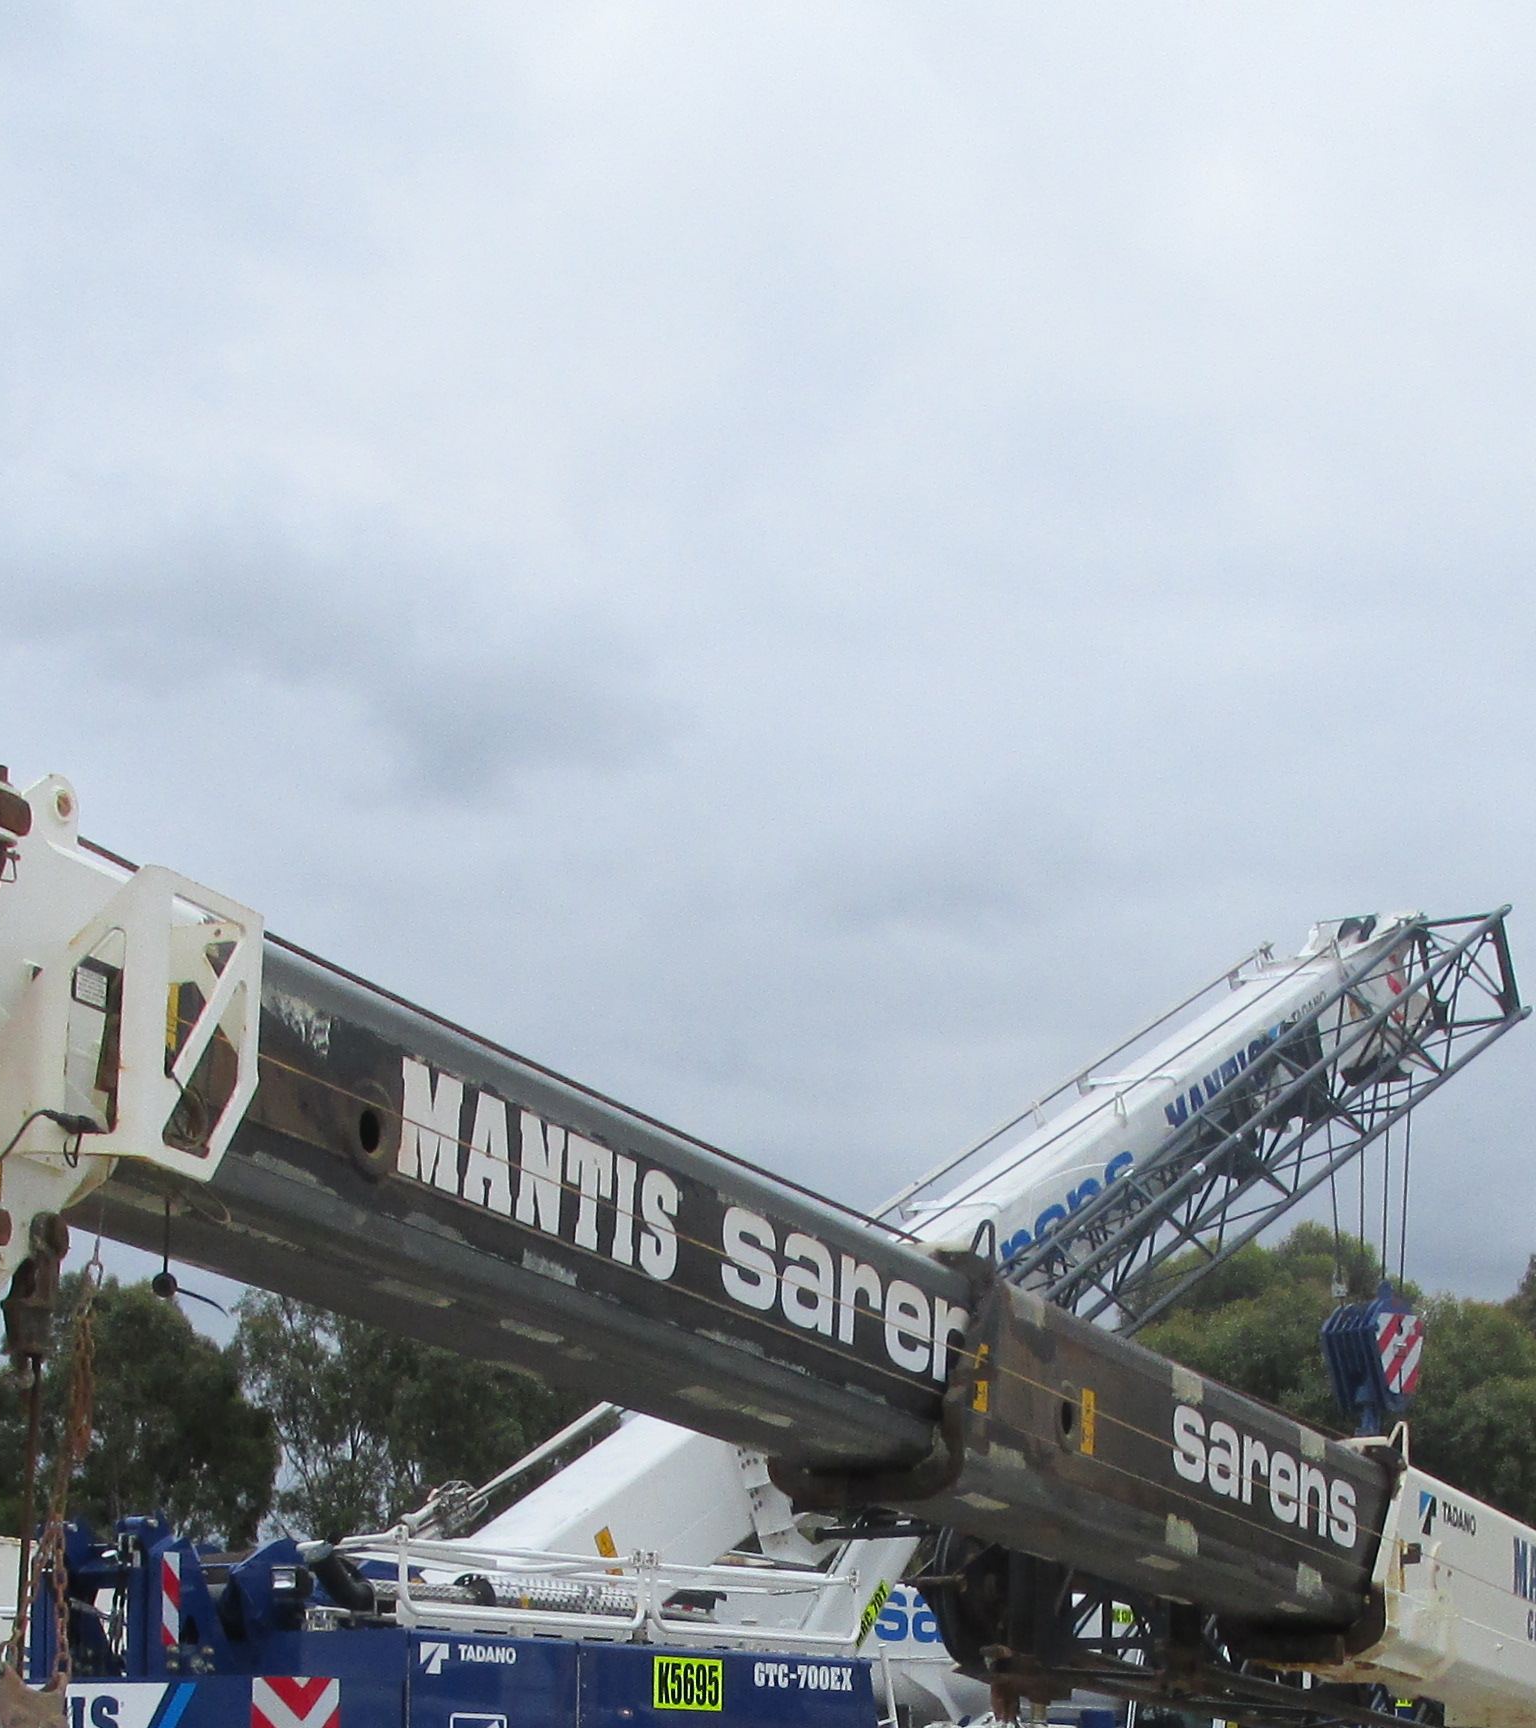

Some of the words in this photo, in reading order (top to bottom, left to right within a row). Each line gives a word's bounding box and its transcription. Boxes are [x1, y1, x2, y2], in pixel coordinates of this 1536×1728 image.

[397, 1055, 681, 1281] MANTIS
[1171, 1403, 1357, 1548] sarens
[1442, 1501, 1477, 1537] TADANO
[458, 1643, 517, 1665] TADANO
[658, 1663, 720, 1707] K5695
[754, 1662, 853, 1692] GTC-700EX
